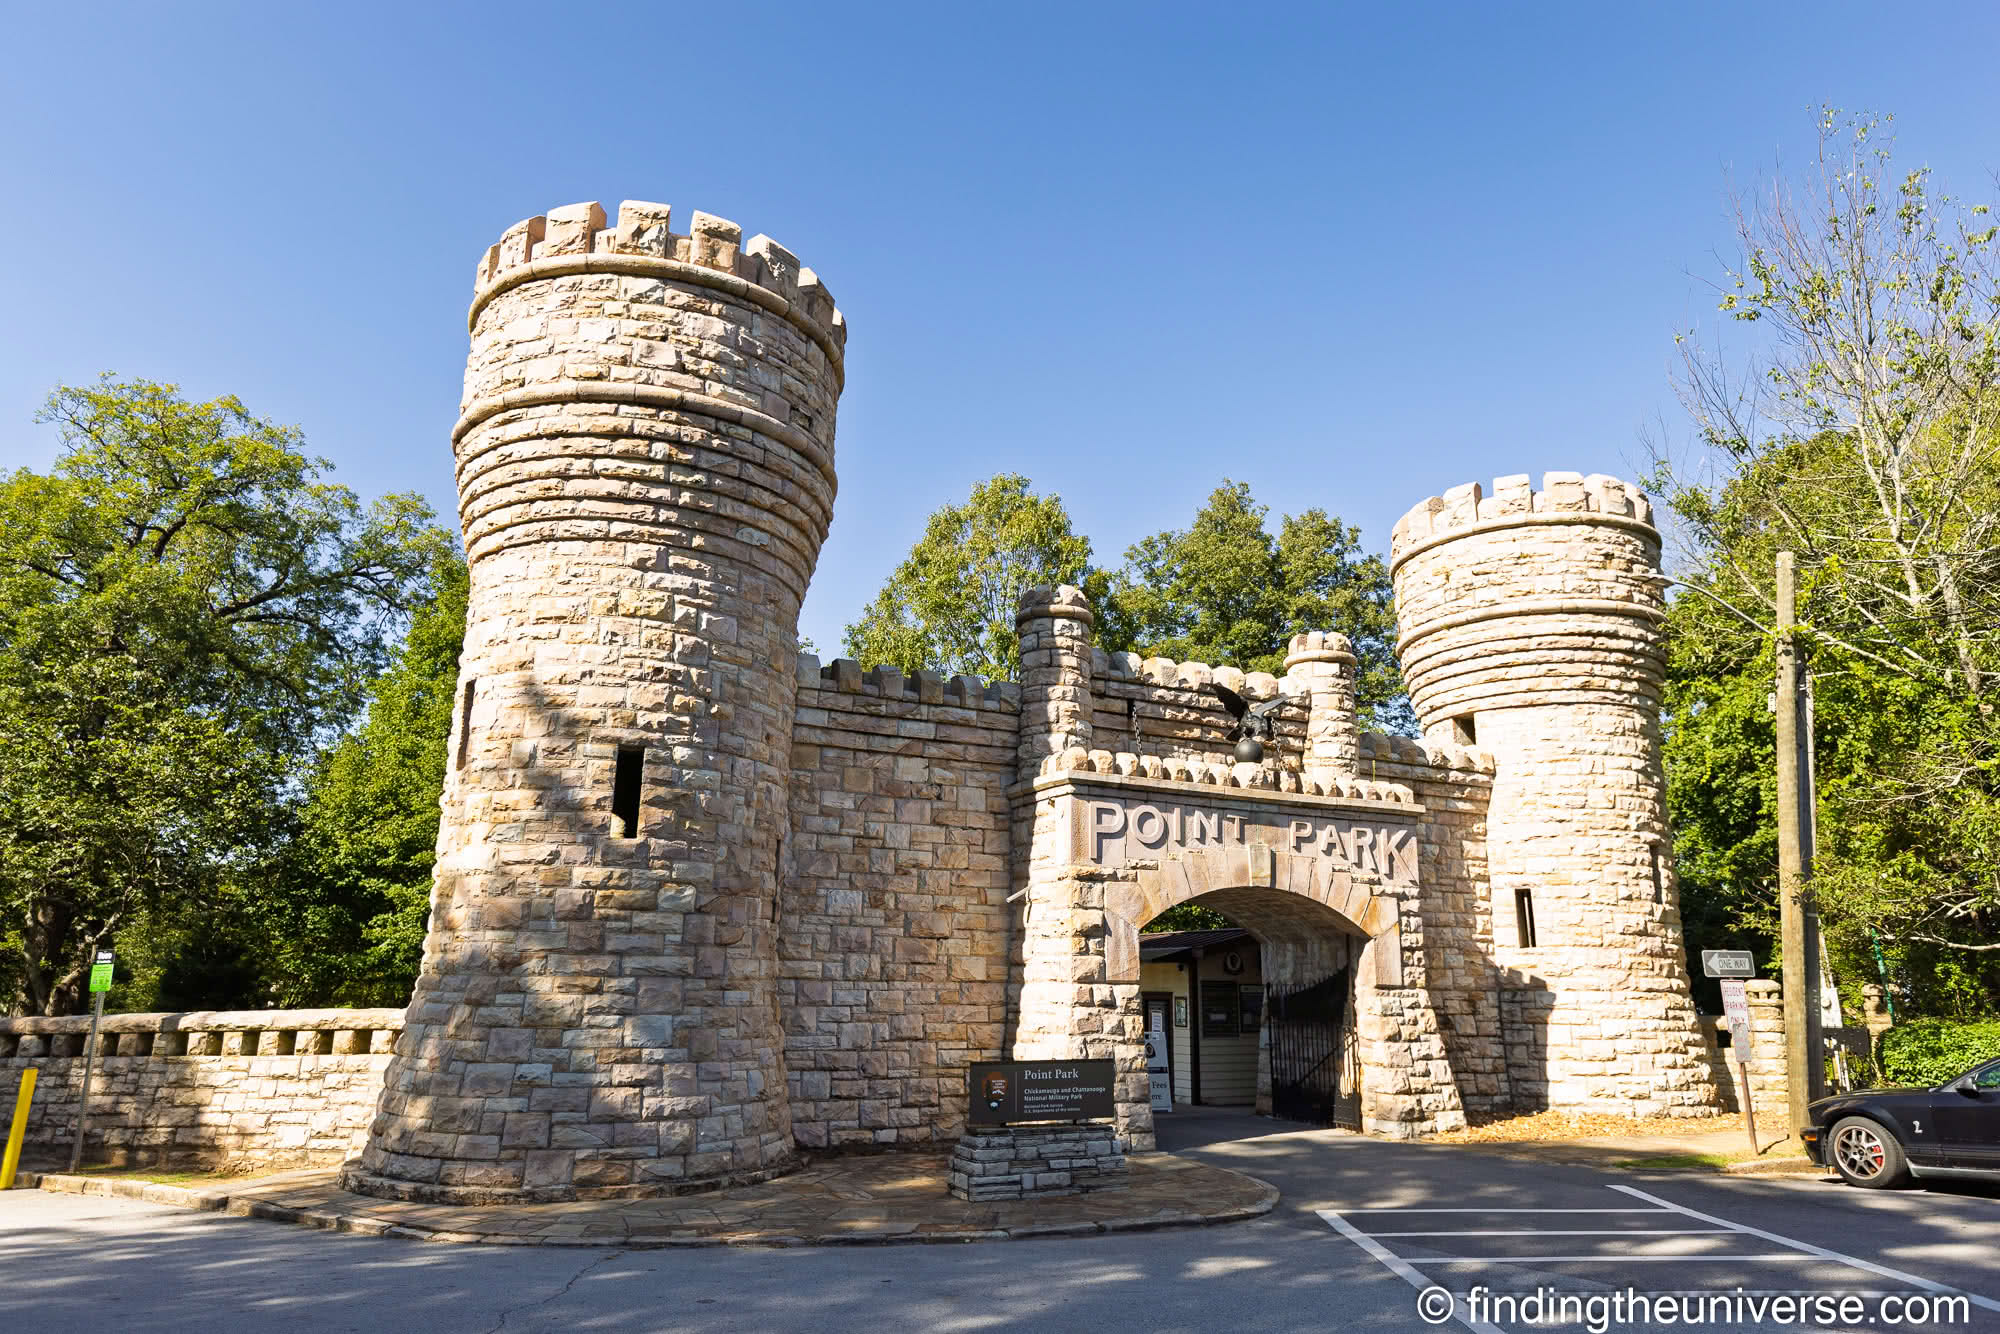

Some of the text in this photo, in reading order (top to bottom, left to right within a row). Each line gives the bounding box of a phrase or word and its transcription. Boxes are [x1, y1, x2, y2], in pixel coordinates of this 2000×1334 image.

[1090, 801, 1418, 885] POINT PARK
[1719, 959, 1747, 968] ONE WAY
[1024, 1068, 1079, 1080] Point Park
